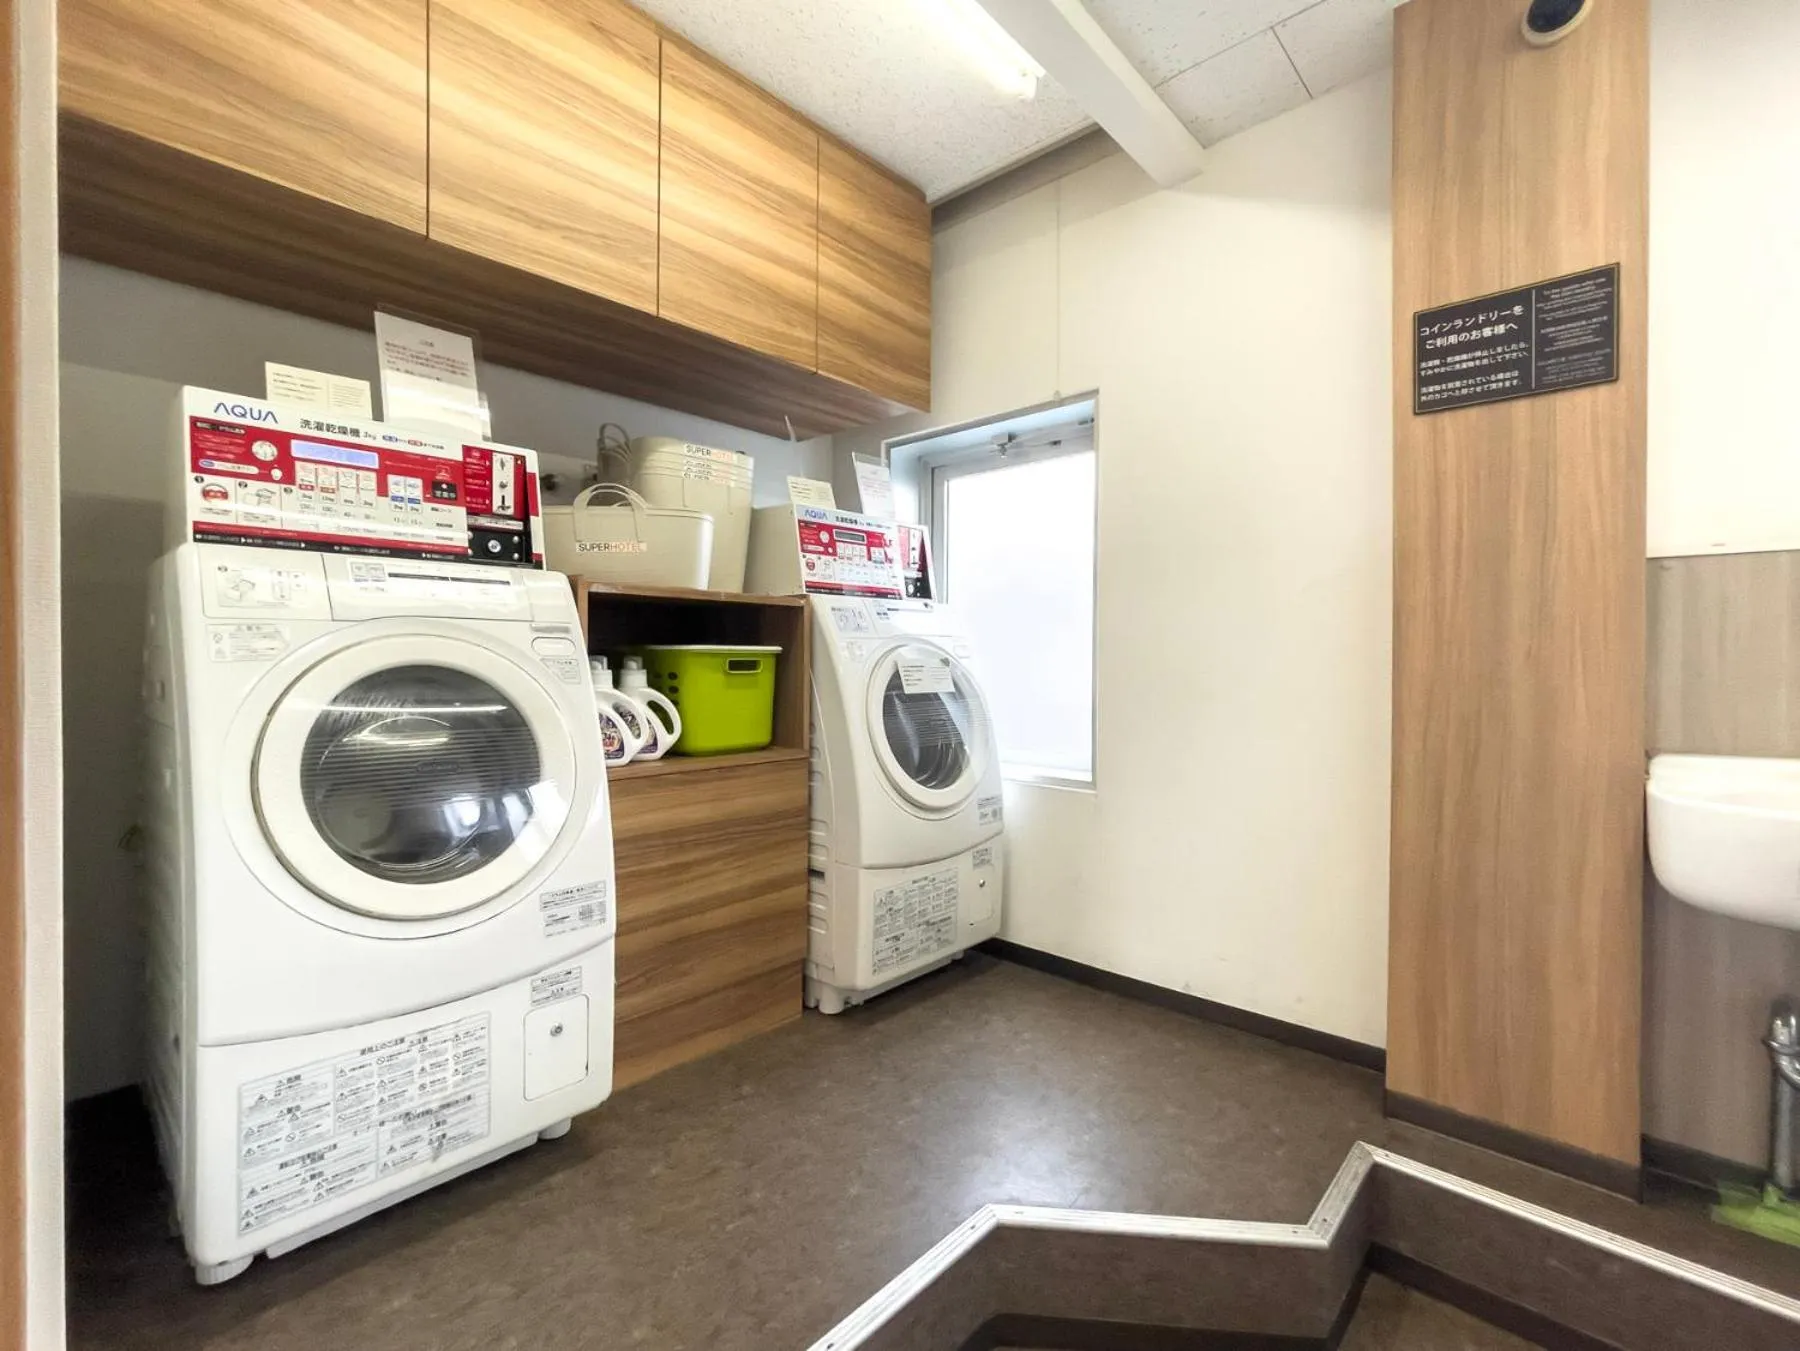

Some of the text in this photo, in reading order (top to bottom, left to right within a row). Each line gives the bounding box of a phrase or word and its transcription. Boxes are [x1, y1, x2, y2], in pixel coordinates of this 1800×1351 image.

[1420, 304, 1524, 336] コインランドリーを
[1425, 322, 1518, 349] ご利用のお客様へ
[214, 402, 279, 424] AQUA
[300, 418, 361, 438] 洗濯乾燥機
[804, 509, 828, 520] AQUA
